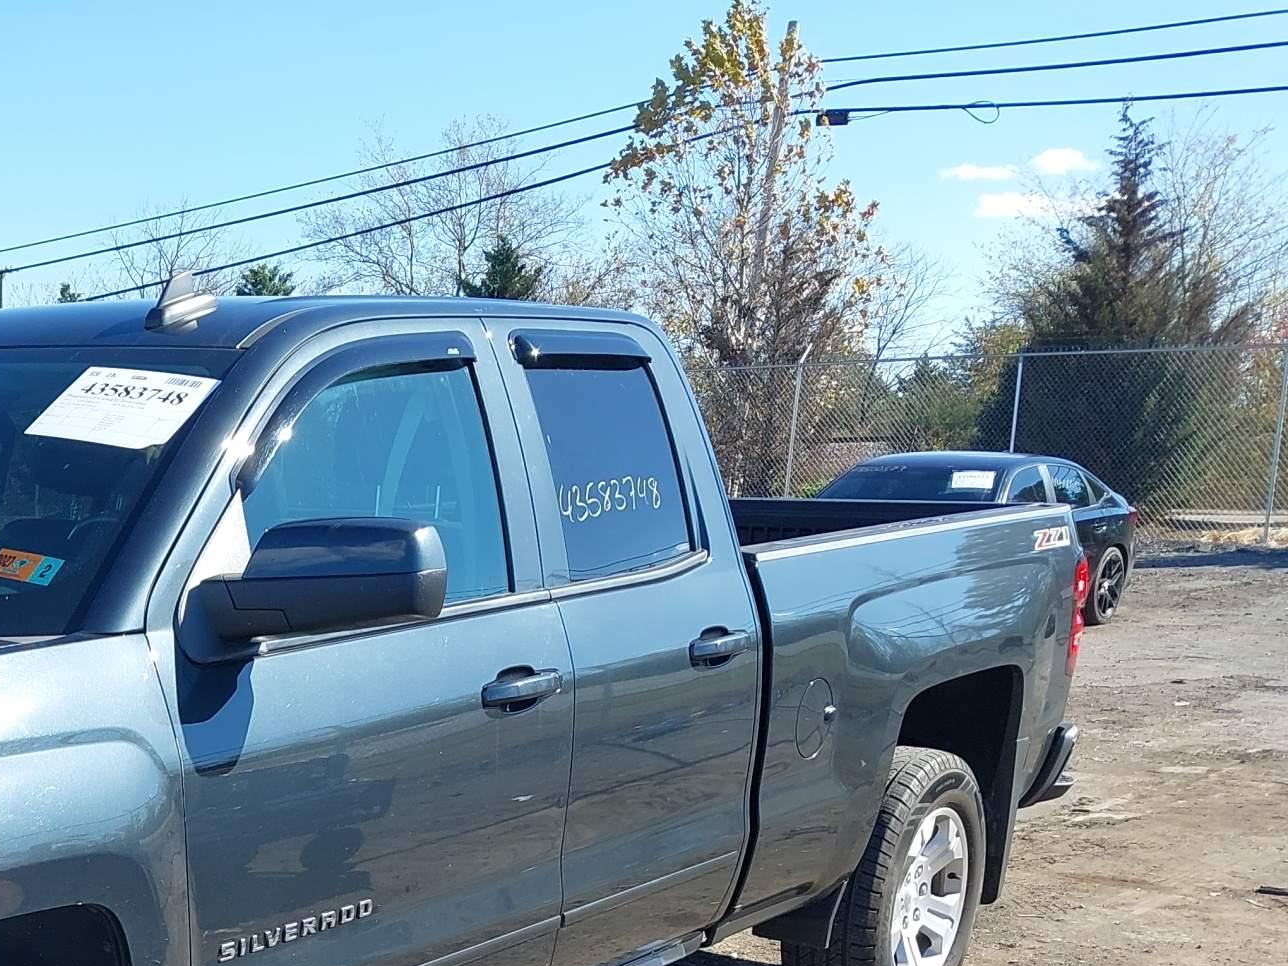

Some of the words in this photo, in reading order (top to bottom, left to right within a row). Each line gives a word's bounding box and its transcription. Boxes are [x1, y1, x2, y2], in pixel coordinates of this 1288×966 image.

[80, 381, 189, 406] 43583748
[558, 475, 661, 523] 43583748
[1033, 525, 1071, 551] Z71
[38, 564, 53, 578] 2
[218, 898, 373, 963] SILVERADO
